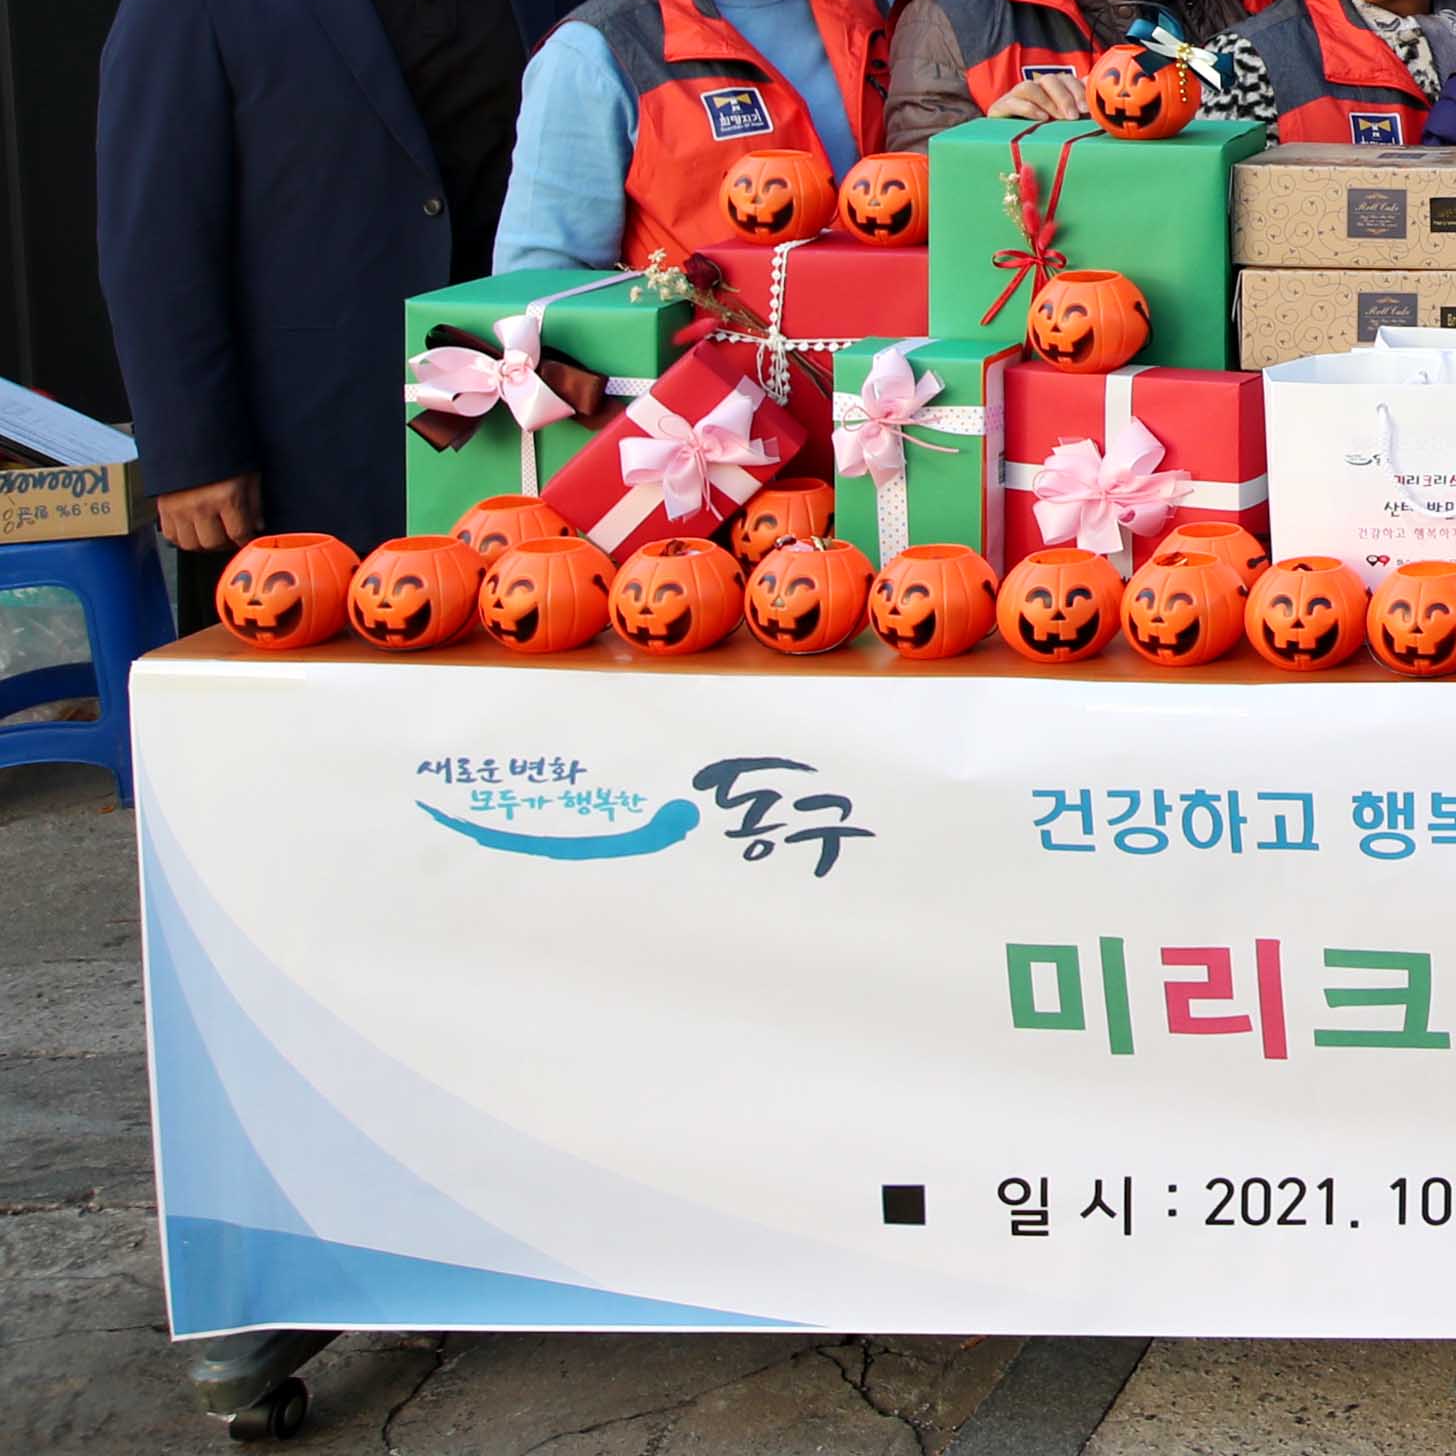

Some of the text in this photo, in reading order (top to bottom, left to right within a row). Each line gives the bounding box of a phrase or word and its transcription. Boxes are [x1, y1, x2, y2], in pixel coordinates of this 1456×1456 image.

[0, 466, 110, 498] Kleenex
[1358, 528, 1406, 539] 건강하고
[417, 757, 587, 785] 새로운 변화
[470, 789, 648, 822] 모두가 행복한
[692, 757, 876, 878] 동구
[1032, 789, 1319, 855] 건강하고
[1205, 1177, 1359, 1228] 2021.
